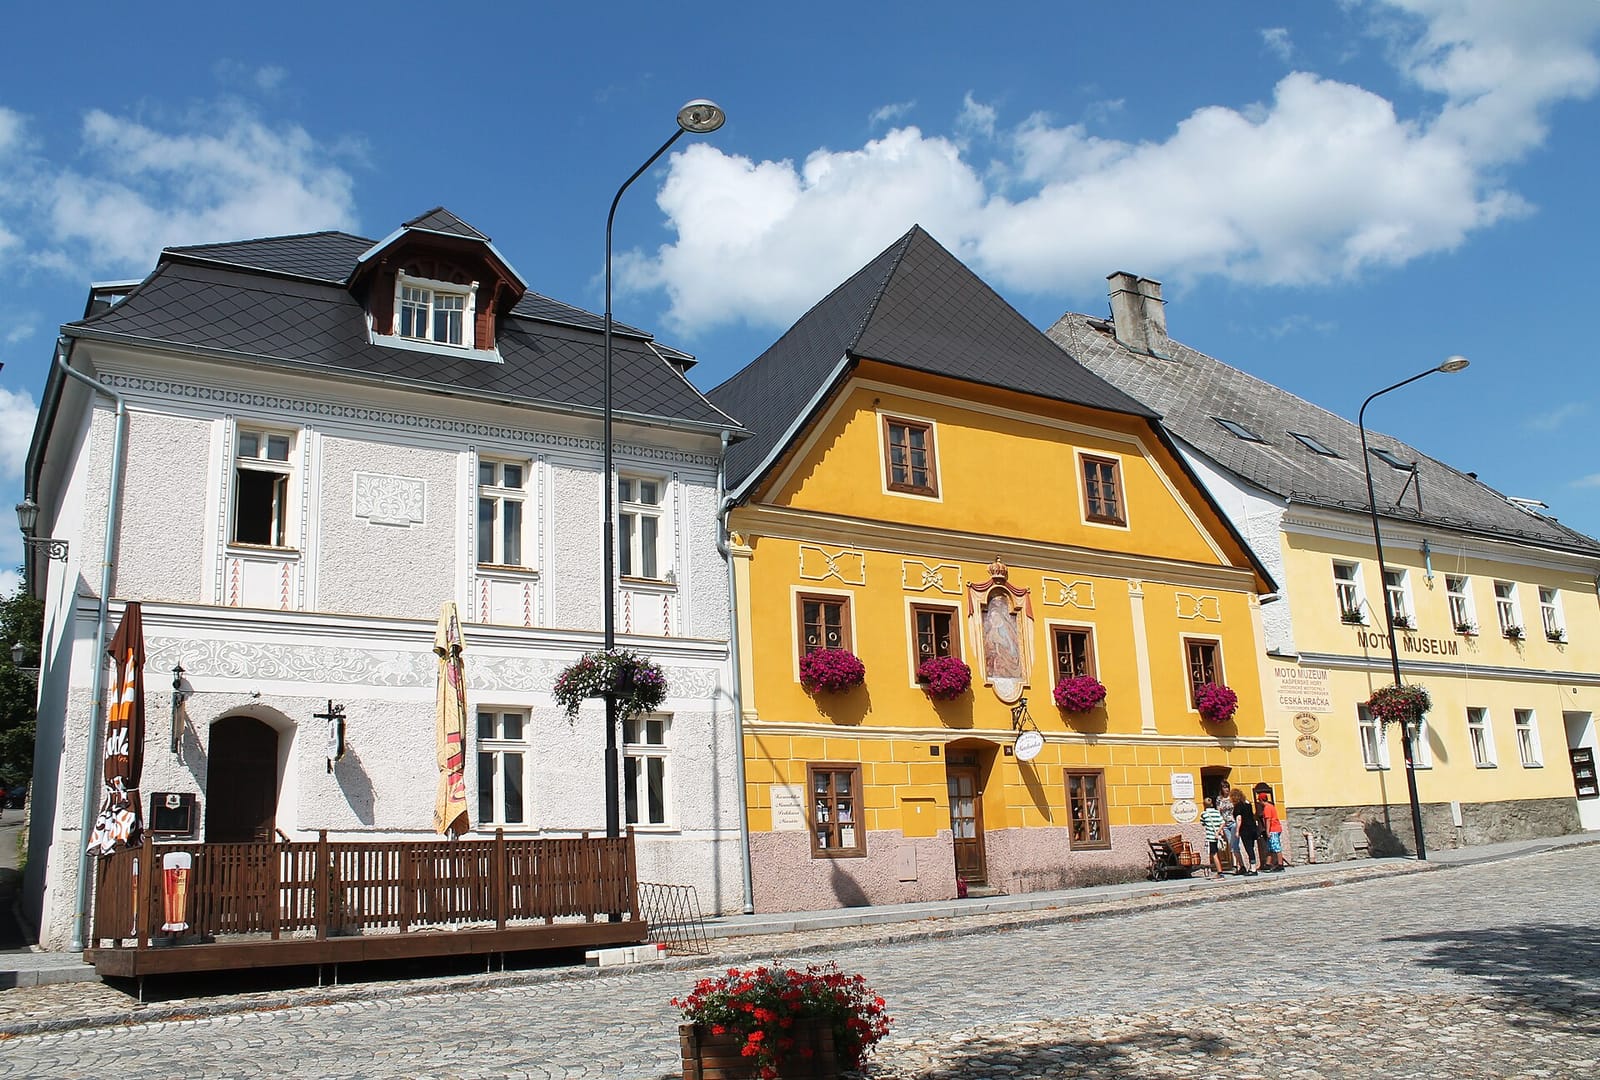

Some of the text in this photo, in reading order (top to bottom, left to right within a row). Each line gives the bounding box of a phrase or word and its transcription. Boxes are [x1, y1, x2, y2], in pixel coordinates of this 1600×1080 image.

[1402, 636, 1459, 656] MUSEUM
[1274, 667, 1328, 681] MOTO MUZEUM
[1279, 694, 1330, 706] ČESKÁ HRAČKA
